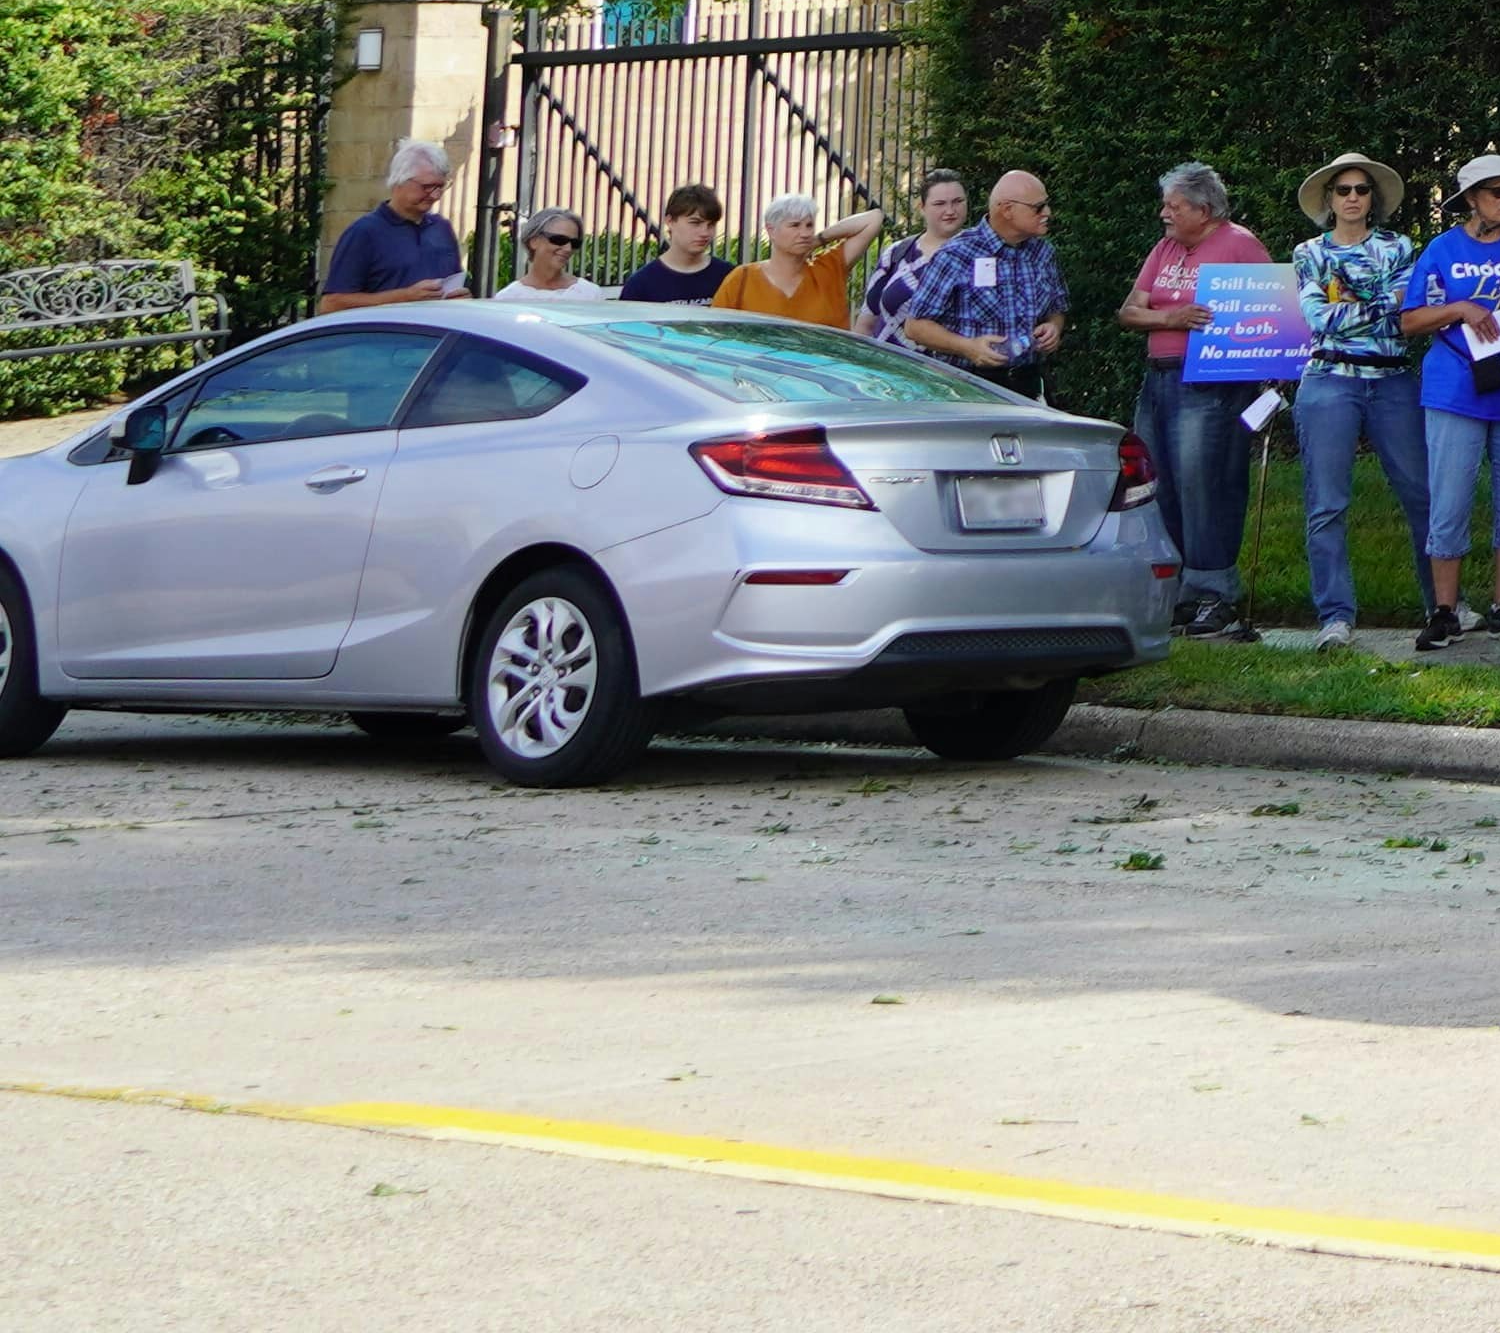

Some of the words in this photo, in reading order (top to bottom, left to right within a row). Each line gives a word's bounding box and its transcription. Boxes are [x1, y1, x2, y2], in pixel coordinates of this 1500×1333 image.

[1160, 264, 1200, 278] ABOLIS
[1153, 276, 1198, 290] ABORTIO
[1210, 277, 1243, 290] Still
[1247, 277, 1285, 290] here.
[1207, 299, 1240, 312] Still
[1243, 303, 1282, 312] care.
[1203, 323, 1230, 335] For
[1235, 322, 1279, 335] both.
[1200, 345, 1223, 359] No
[1226, 348, 1282, 358] matter
